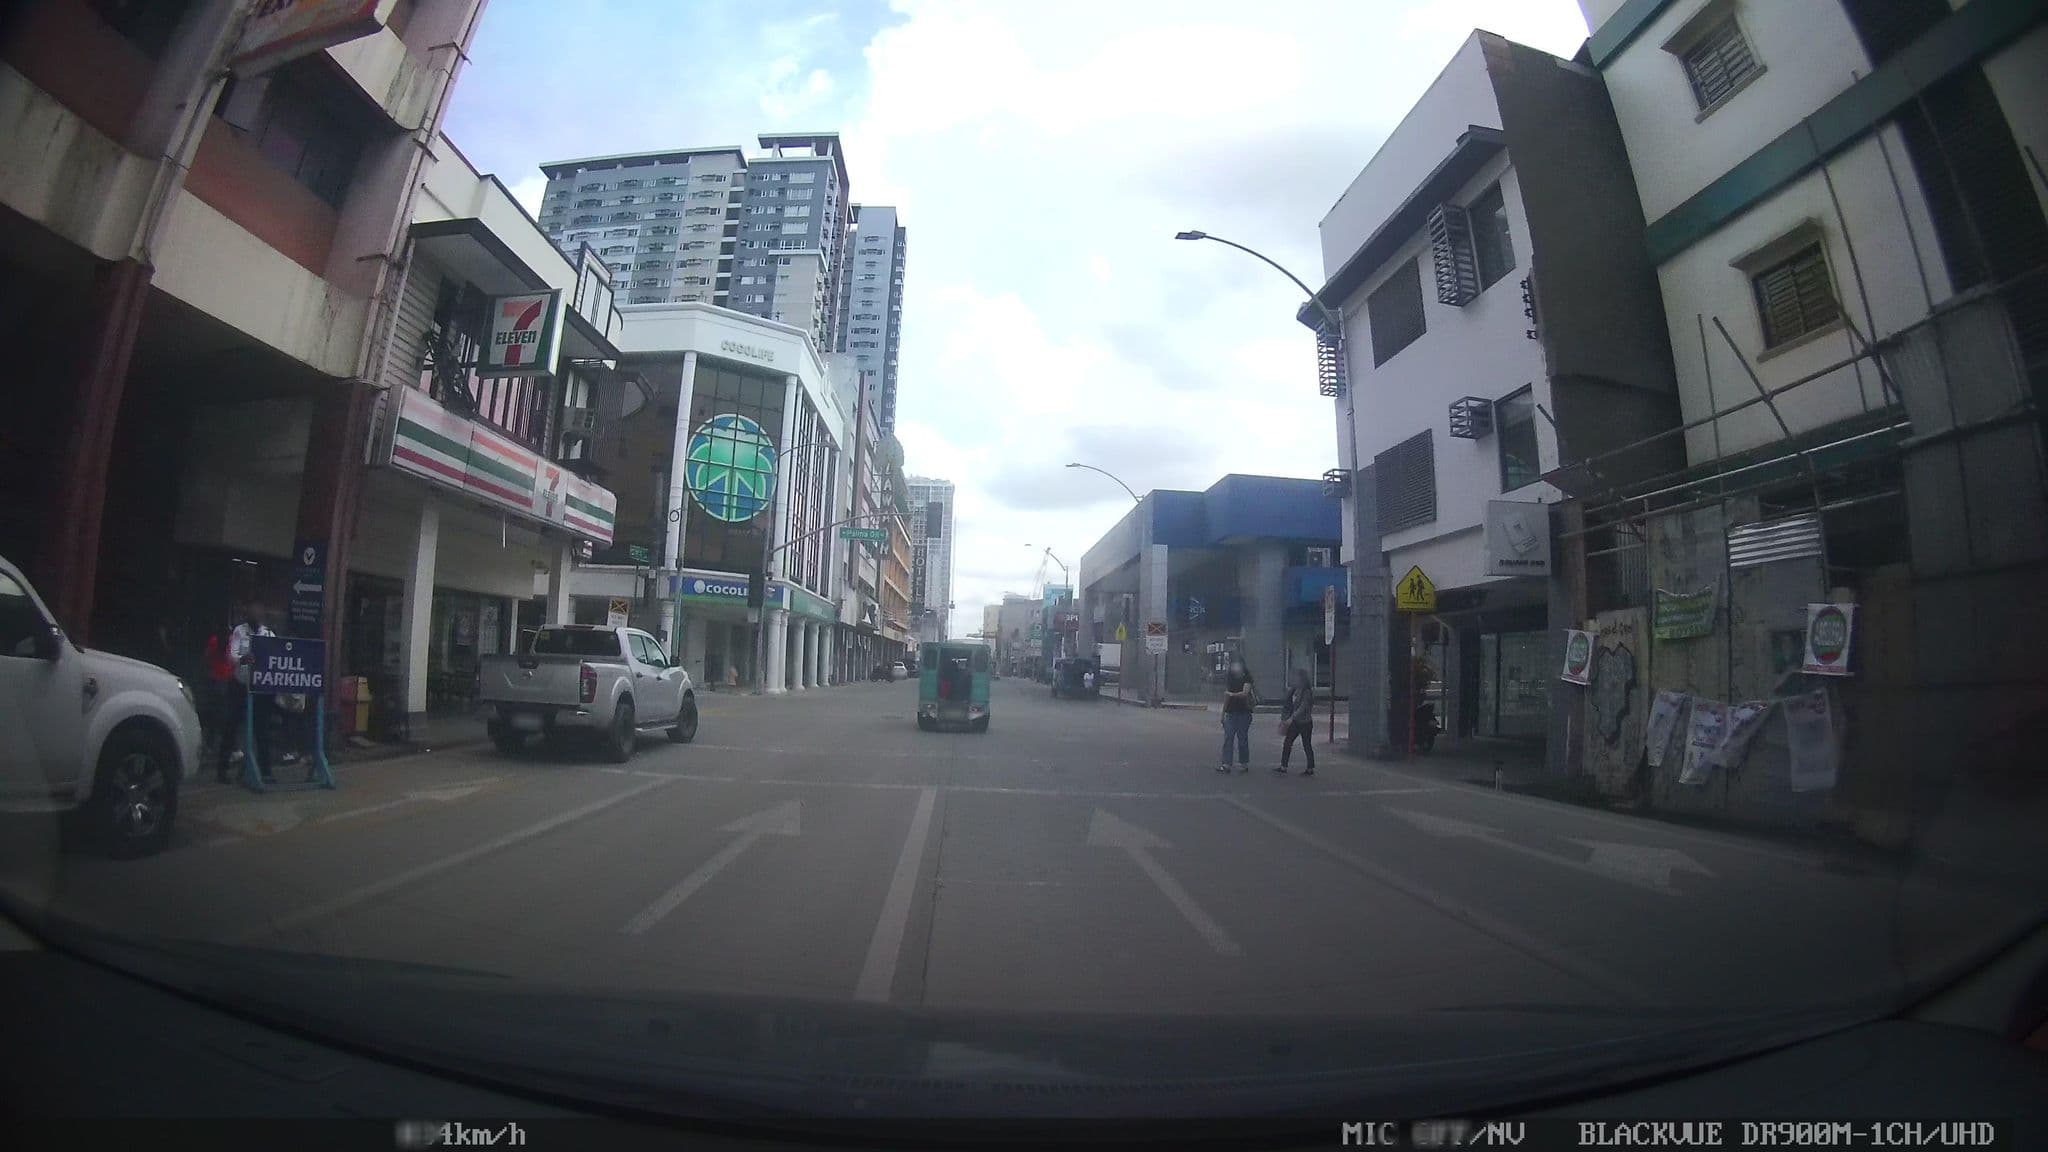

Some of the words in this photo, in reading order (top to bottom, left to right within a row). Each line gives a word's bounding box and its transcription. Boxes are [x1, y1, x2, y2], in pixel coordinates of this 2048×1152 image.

[503, 300, 542, 367] 7
[268, 656, 304, 671] FULL
[253, 671, 322, 687] PARKING
